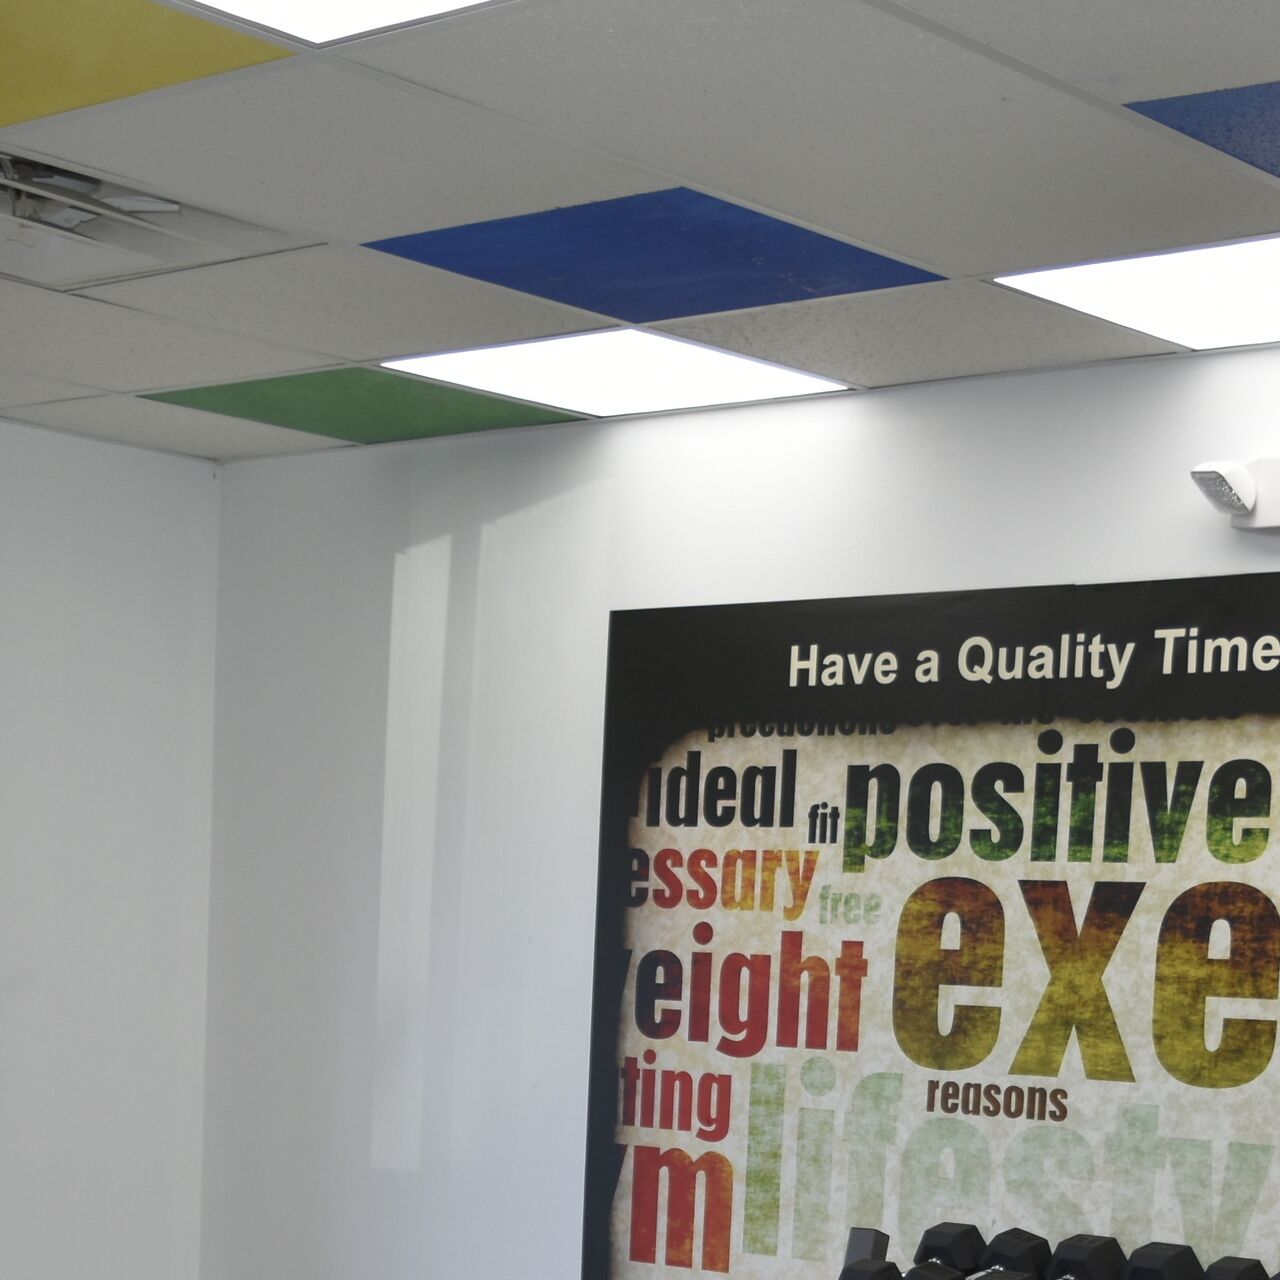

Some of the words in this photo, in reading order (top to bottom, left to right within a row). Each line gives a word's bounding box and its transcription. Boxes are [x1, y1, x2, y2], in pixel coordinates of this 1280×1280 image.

[788, 644, 898, 687] Have
[915, 649, 939, 684] a
[957, 633, 1135, 689] Quality
[645, 749, 797, 828] ideal
[842, 727, 1273, 873] positive
[808, 801, 840, 844] fit
[818, 881, 882, 925] free
[621, 1049, 732, 1142] ting
[927, 1079, 1068, 1122] reasons
